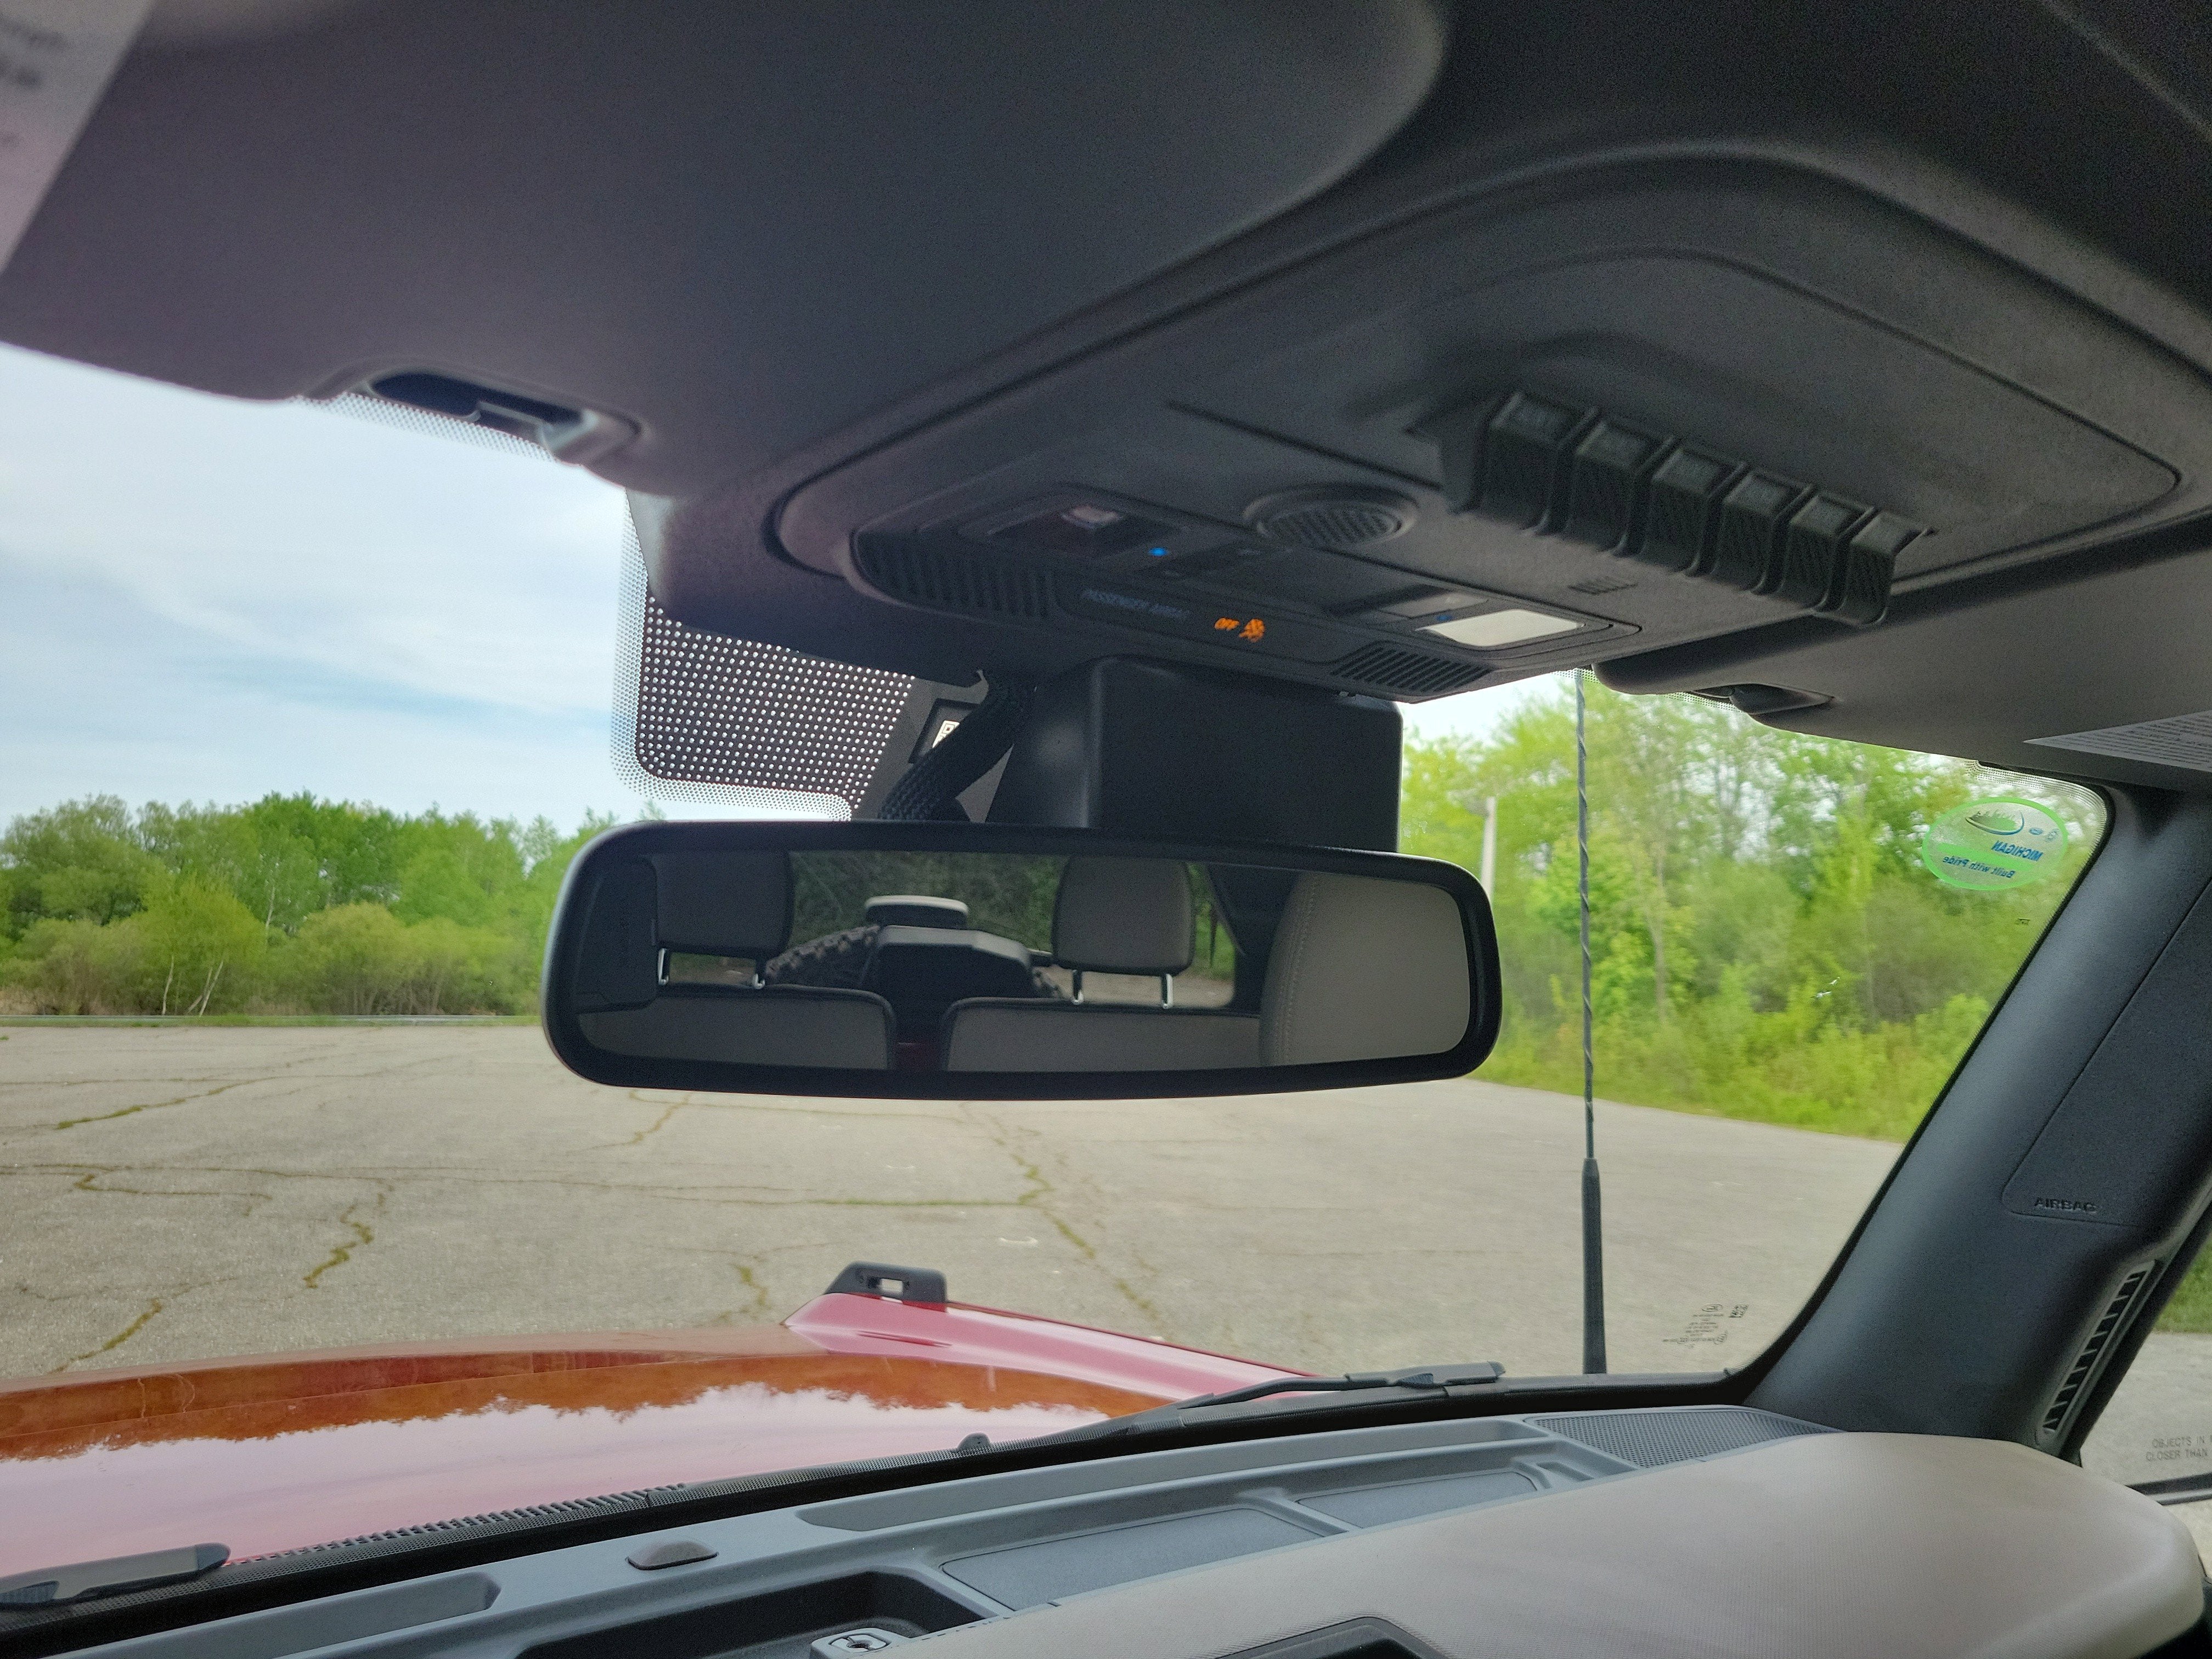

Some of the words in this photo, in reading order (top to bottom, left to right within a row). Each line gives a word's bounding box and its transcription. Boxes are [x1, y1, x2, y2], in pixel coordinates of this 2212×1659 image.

[1214, 617, 1240, 631] OFF
[2034, 1197, 2097, 1212] AIRBAG
[2152, 1436, 2192, 1448] OBJECTS
[2196, 1435, 2205, 1444] IN
[2145, 1449, 2181, 1462] CLOSER
[2185, 1448, 2208, 1459] THAN
